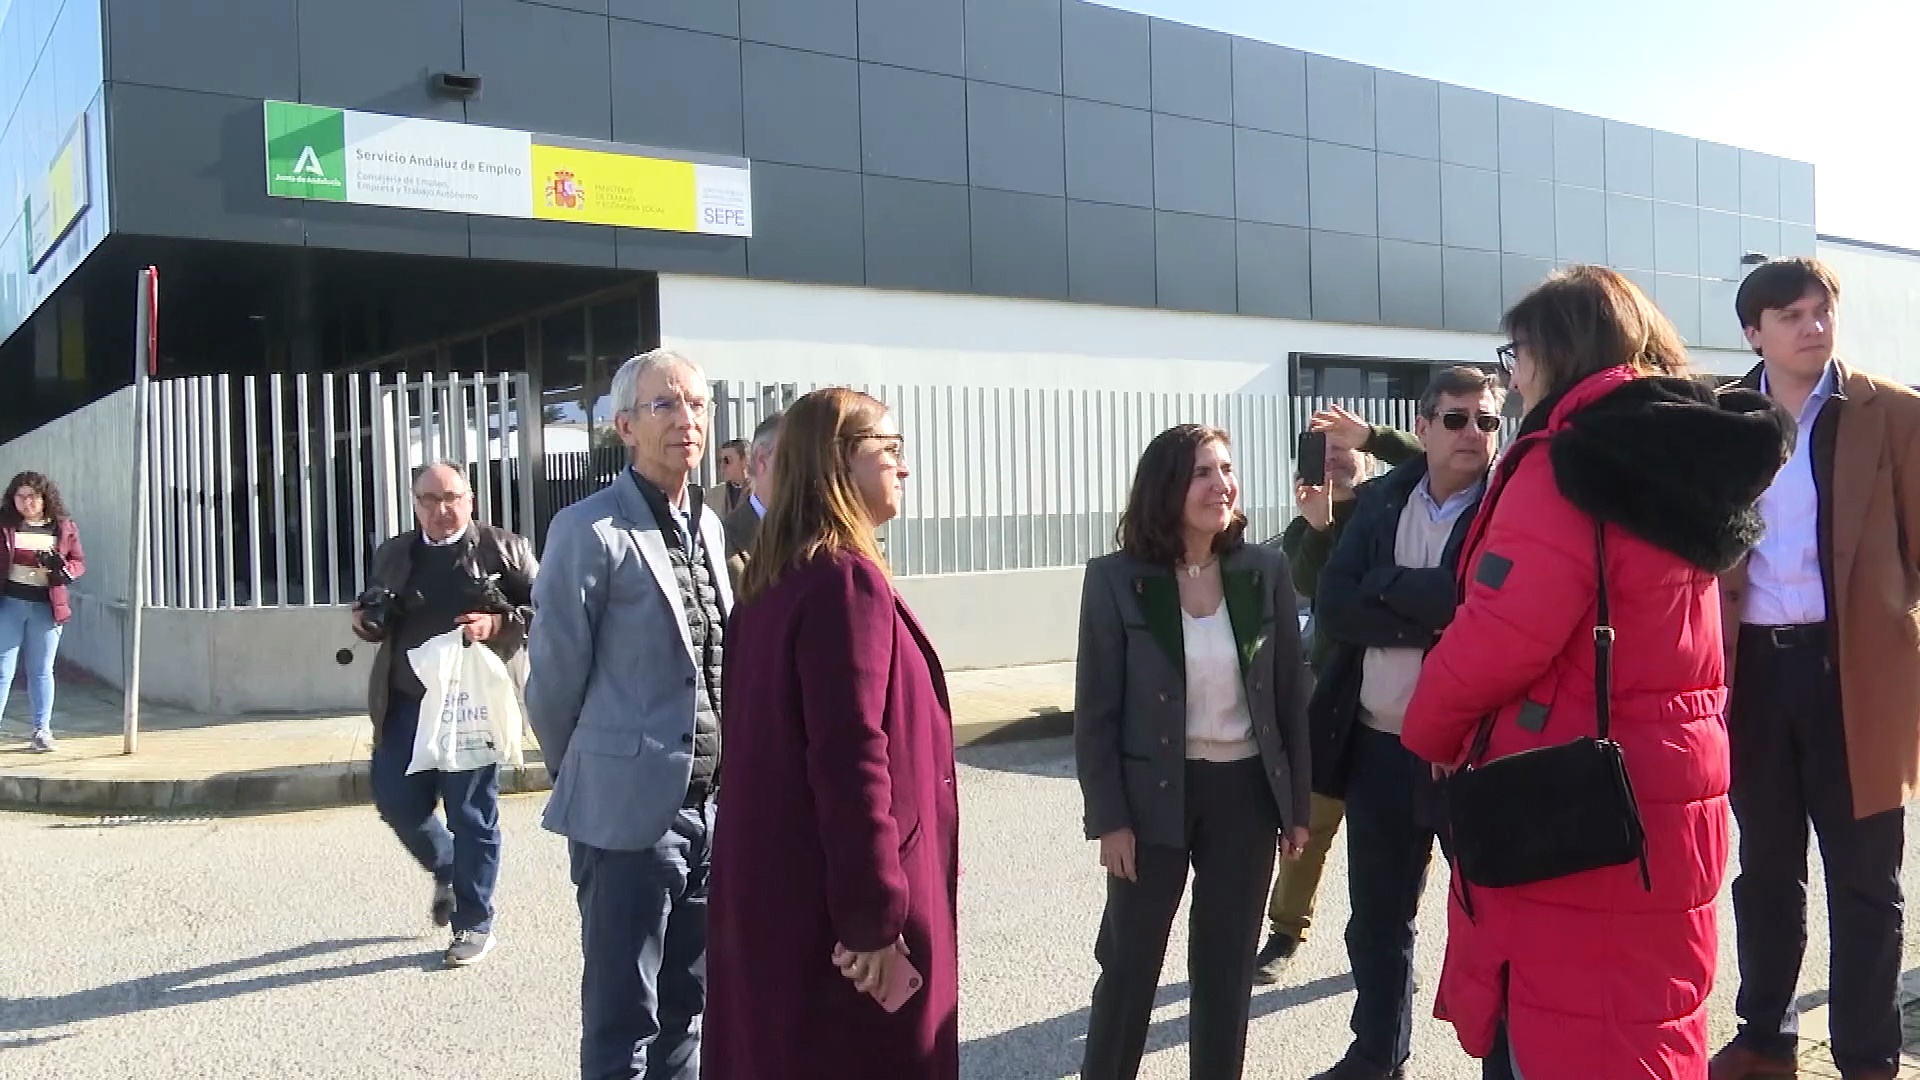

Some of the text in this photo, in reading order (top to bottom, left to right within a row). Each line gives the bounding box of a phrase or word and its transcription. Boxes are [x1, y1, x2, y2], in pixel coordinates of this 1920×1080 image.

[356, 147, 522, 177] Servicio Andaluz de Empleo
[403, 175, 414, 185] de
[356, 181, 479, 200] Empresa y Trabajo Autónomo
[704, 207, 745, 227] SEPE
